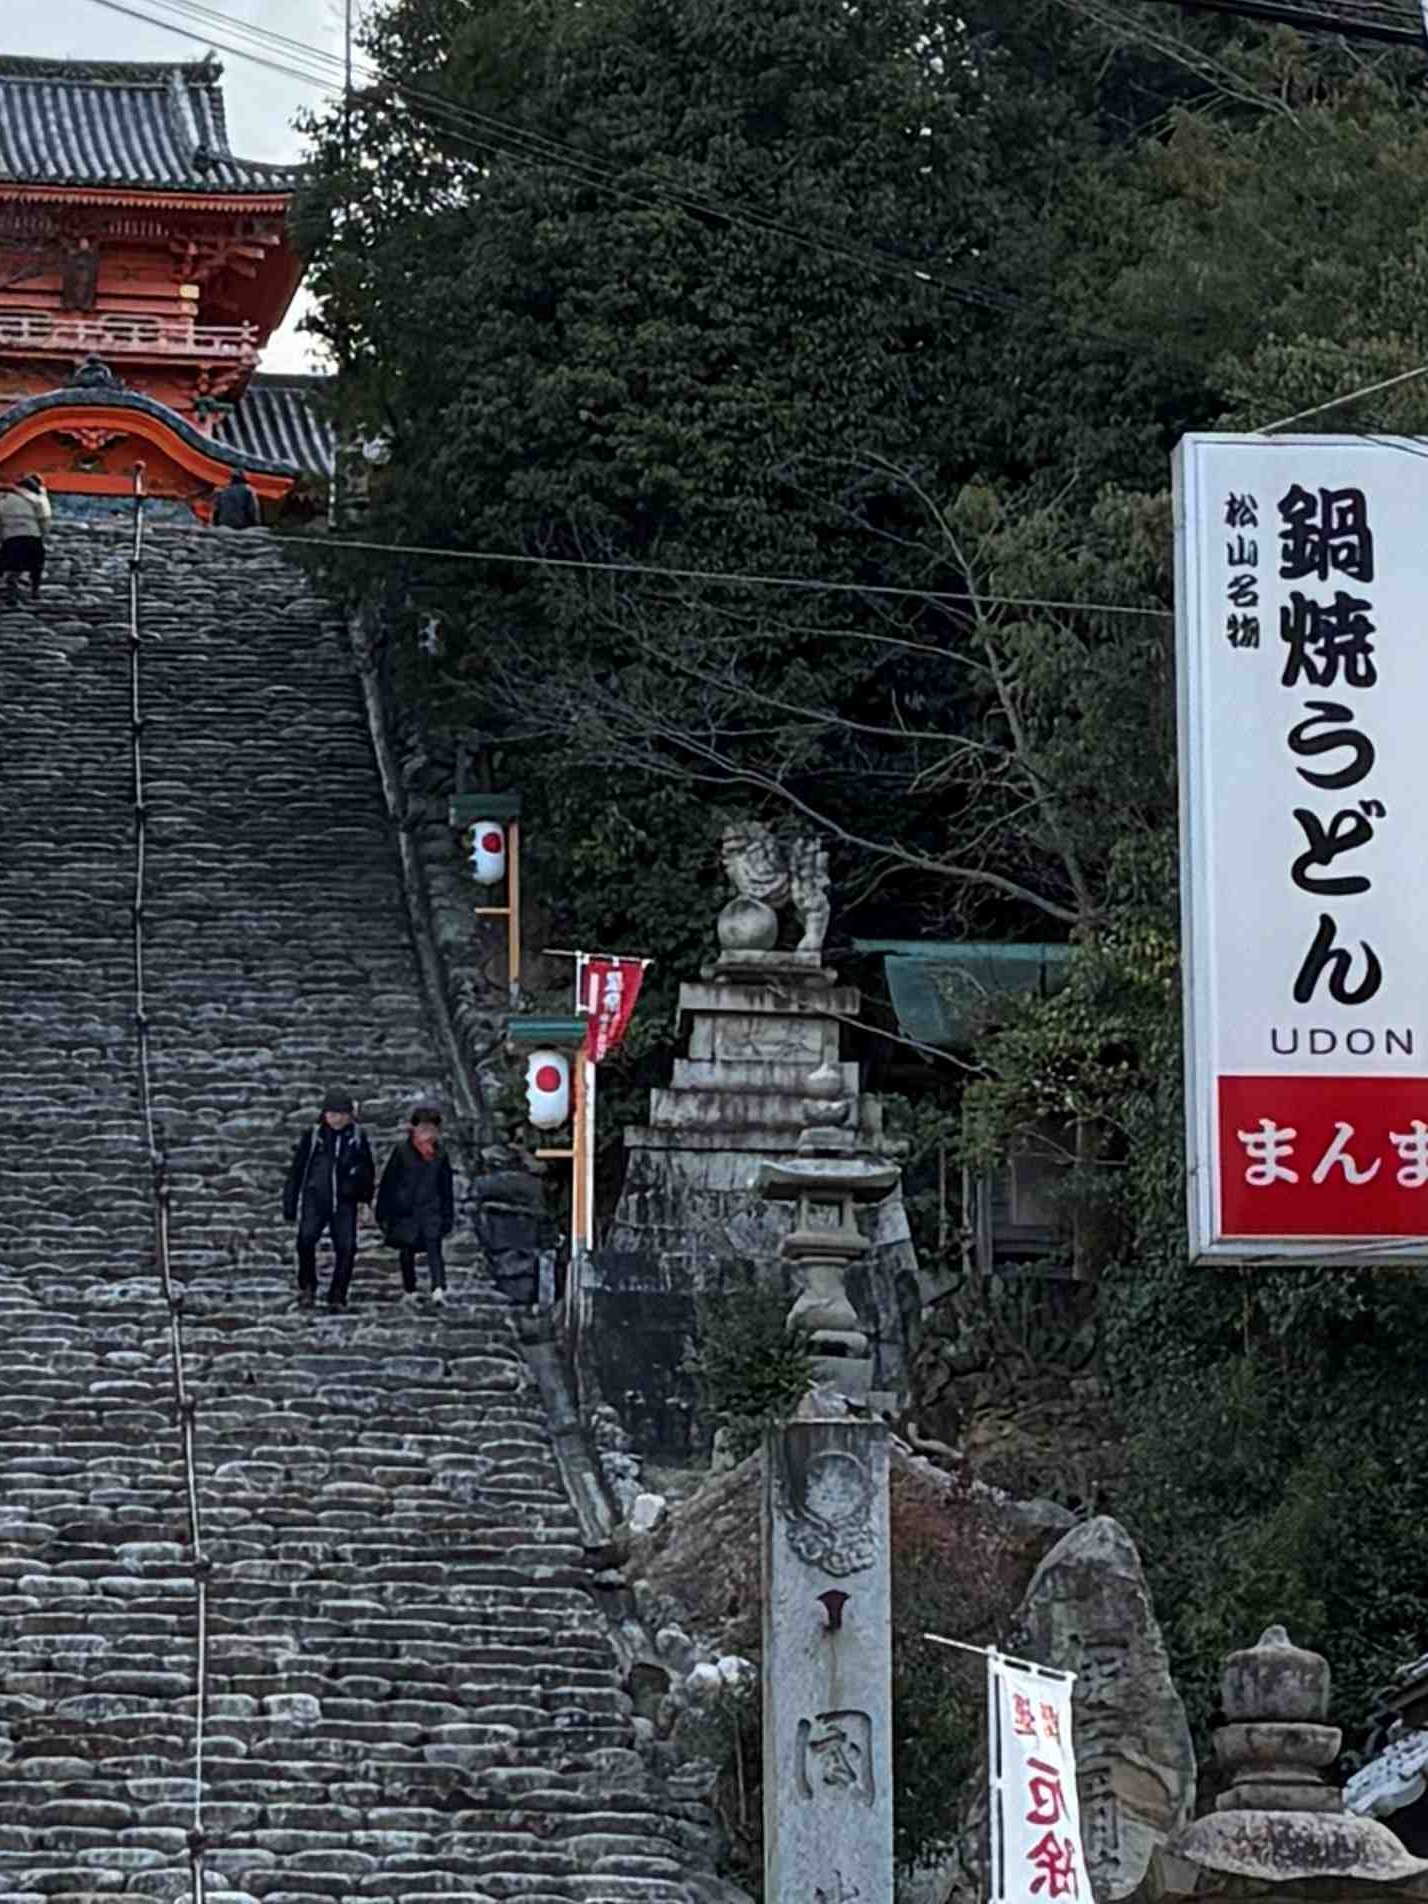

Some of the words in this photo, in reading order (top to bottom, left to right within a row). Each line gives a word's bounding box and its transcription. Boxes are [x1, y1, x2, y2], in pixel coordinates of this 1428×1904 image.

[1225, 492, 1260, 649] 松山名物
[1277, 483, 1387, 1006] 鍋焼うどん
[1271, 1027, 1413, 1056] UDON
